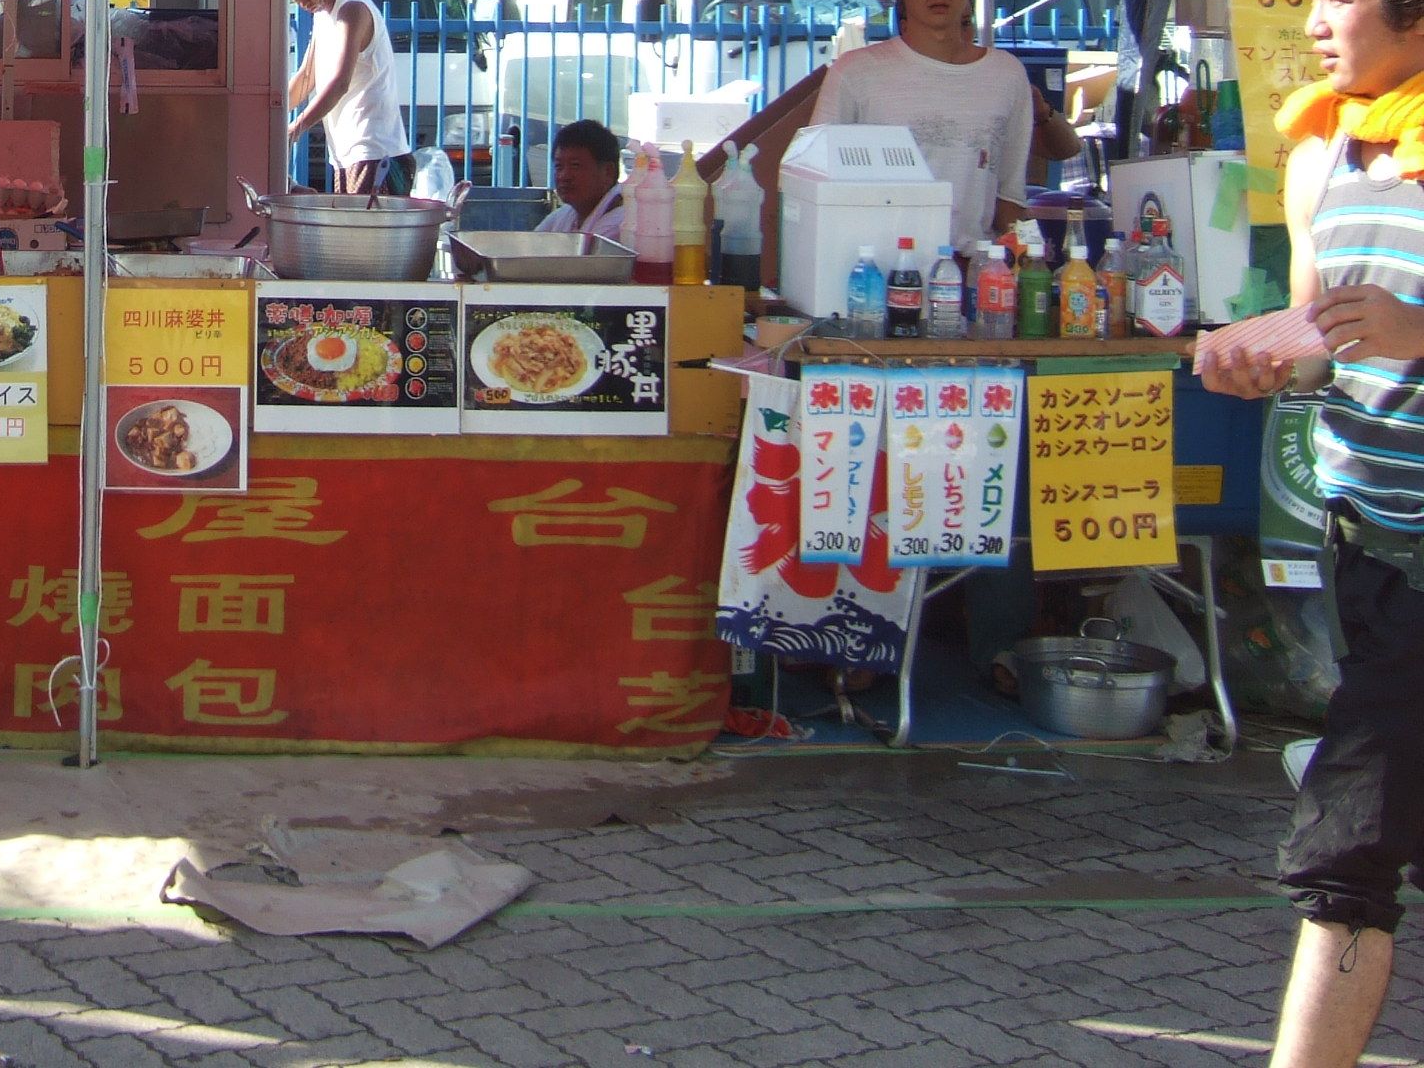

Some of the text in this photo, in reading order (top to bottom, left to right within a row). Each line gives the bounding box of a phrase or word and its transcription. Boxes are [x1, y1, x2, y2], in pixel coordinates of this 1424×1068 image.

[123, 309, 226, 329] 四川麻婆丼
[129, 356, 222, 377] 500円
[1041, 382, 1166, 409] カシスソーダ
[1034, 407, 1172, 434] カシスオレンジ
[1035, 434, 1168, 460] カシスウーロン
[903, 462, 923, 531] レモン
[943, 462, 965, 529] いちご
[980, 463, 1004, 527] メロン
[1040, 479, 1161, 505] カシスコーラ
[1053, 512, 1159, 543] 500円
